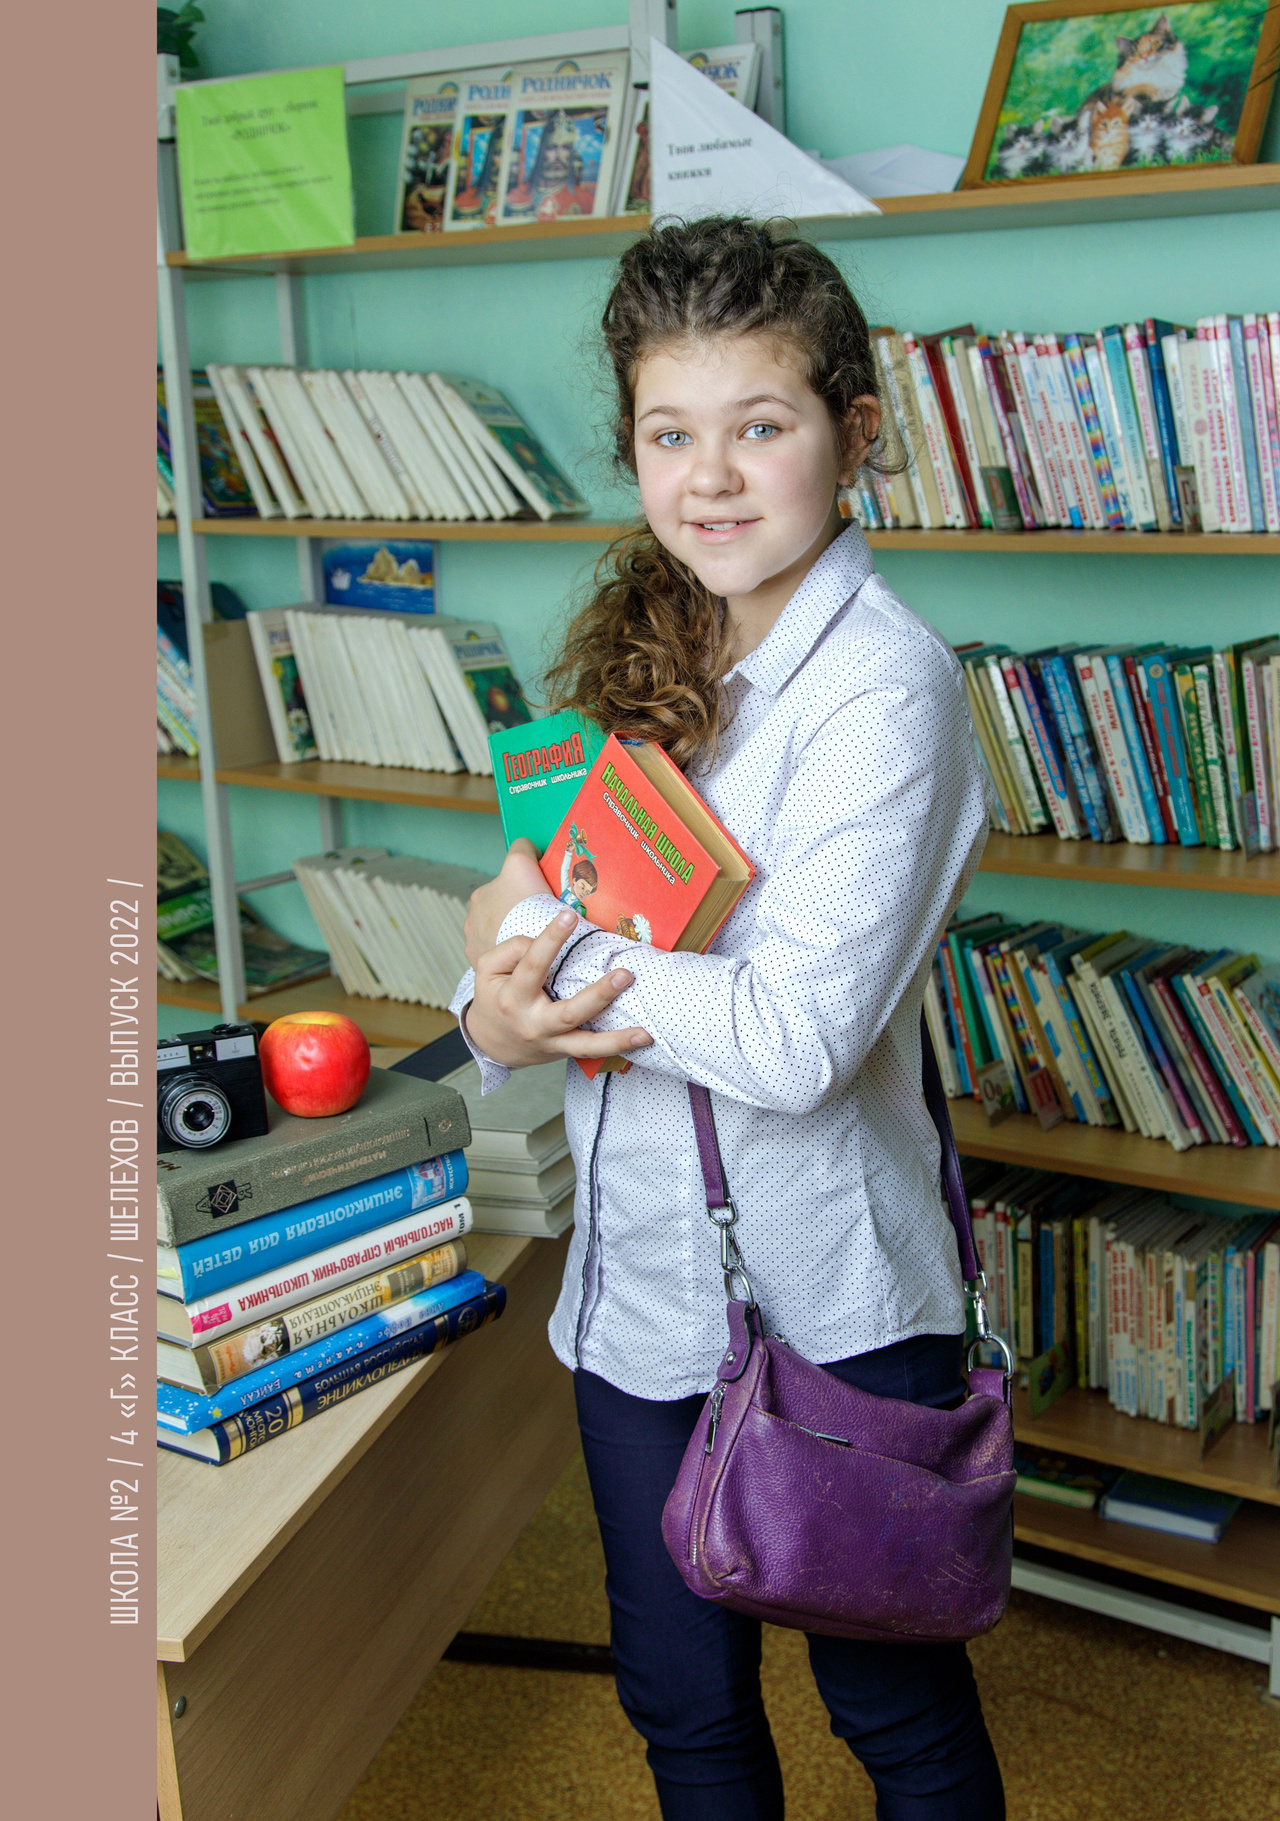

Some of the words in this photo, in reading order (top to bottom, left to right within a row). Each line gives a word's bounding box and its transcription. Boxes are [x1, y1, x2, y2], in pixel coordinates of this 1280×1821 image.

[502, 732, 585, 783] ГЕОГРАФИЯ
[509, 779, 547, 795] Справочник
[551, 767, 588, 784] школьника
[600, 762, 658, 841] НАЧАЛЬНАЯ
[654, 828, 696, 885] ШКОЛА
[602, 792, 640, 840] Справочник
[640, 840, 676, 885] школьника
[283, 1184, 405, 1241] ЭНЦИКЛОПЕДИЯ
[382, 1213, 455, 1255] НАСТОЛЬНЫЙ
[189, 1244, 245, 1278] ДЕТЕЙ
[246, 1230, 282, 1254] ДЛЯ
[310, 1241, 383, 1284] СПРАВОЧНИК
[236, 1269, 312, 1313] ШКОЛЬНИКА
[286, 1278, 384, 1329] ЭНЦИКЛОПЕДИЯ
[288, 1293, 387, 1345] ШКОЛЬНАЯ
[238, 1377, 283, 1405] БАЙКАЛ
[312, 1361, 364, 1393] БОЛЬШАЯ
[260, 1402, 289, 1433] 20
